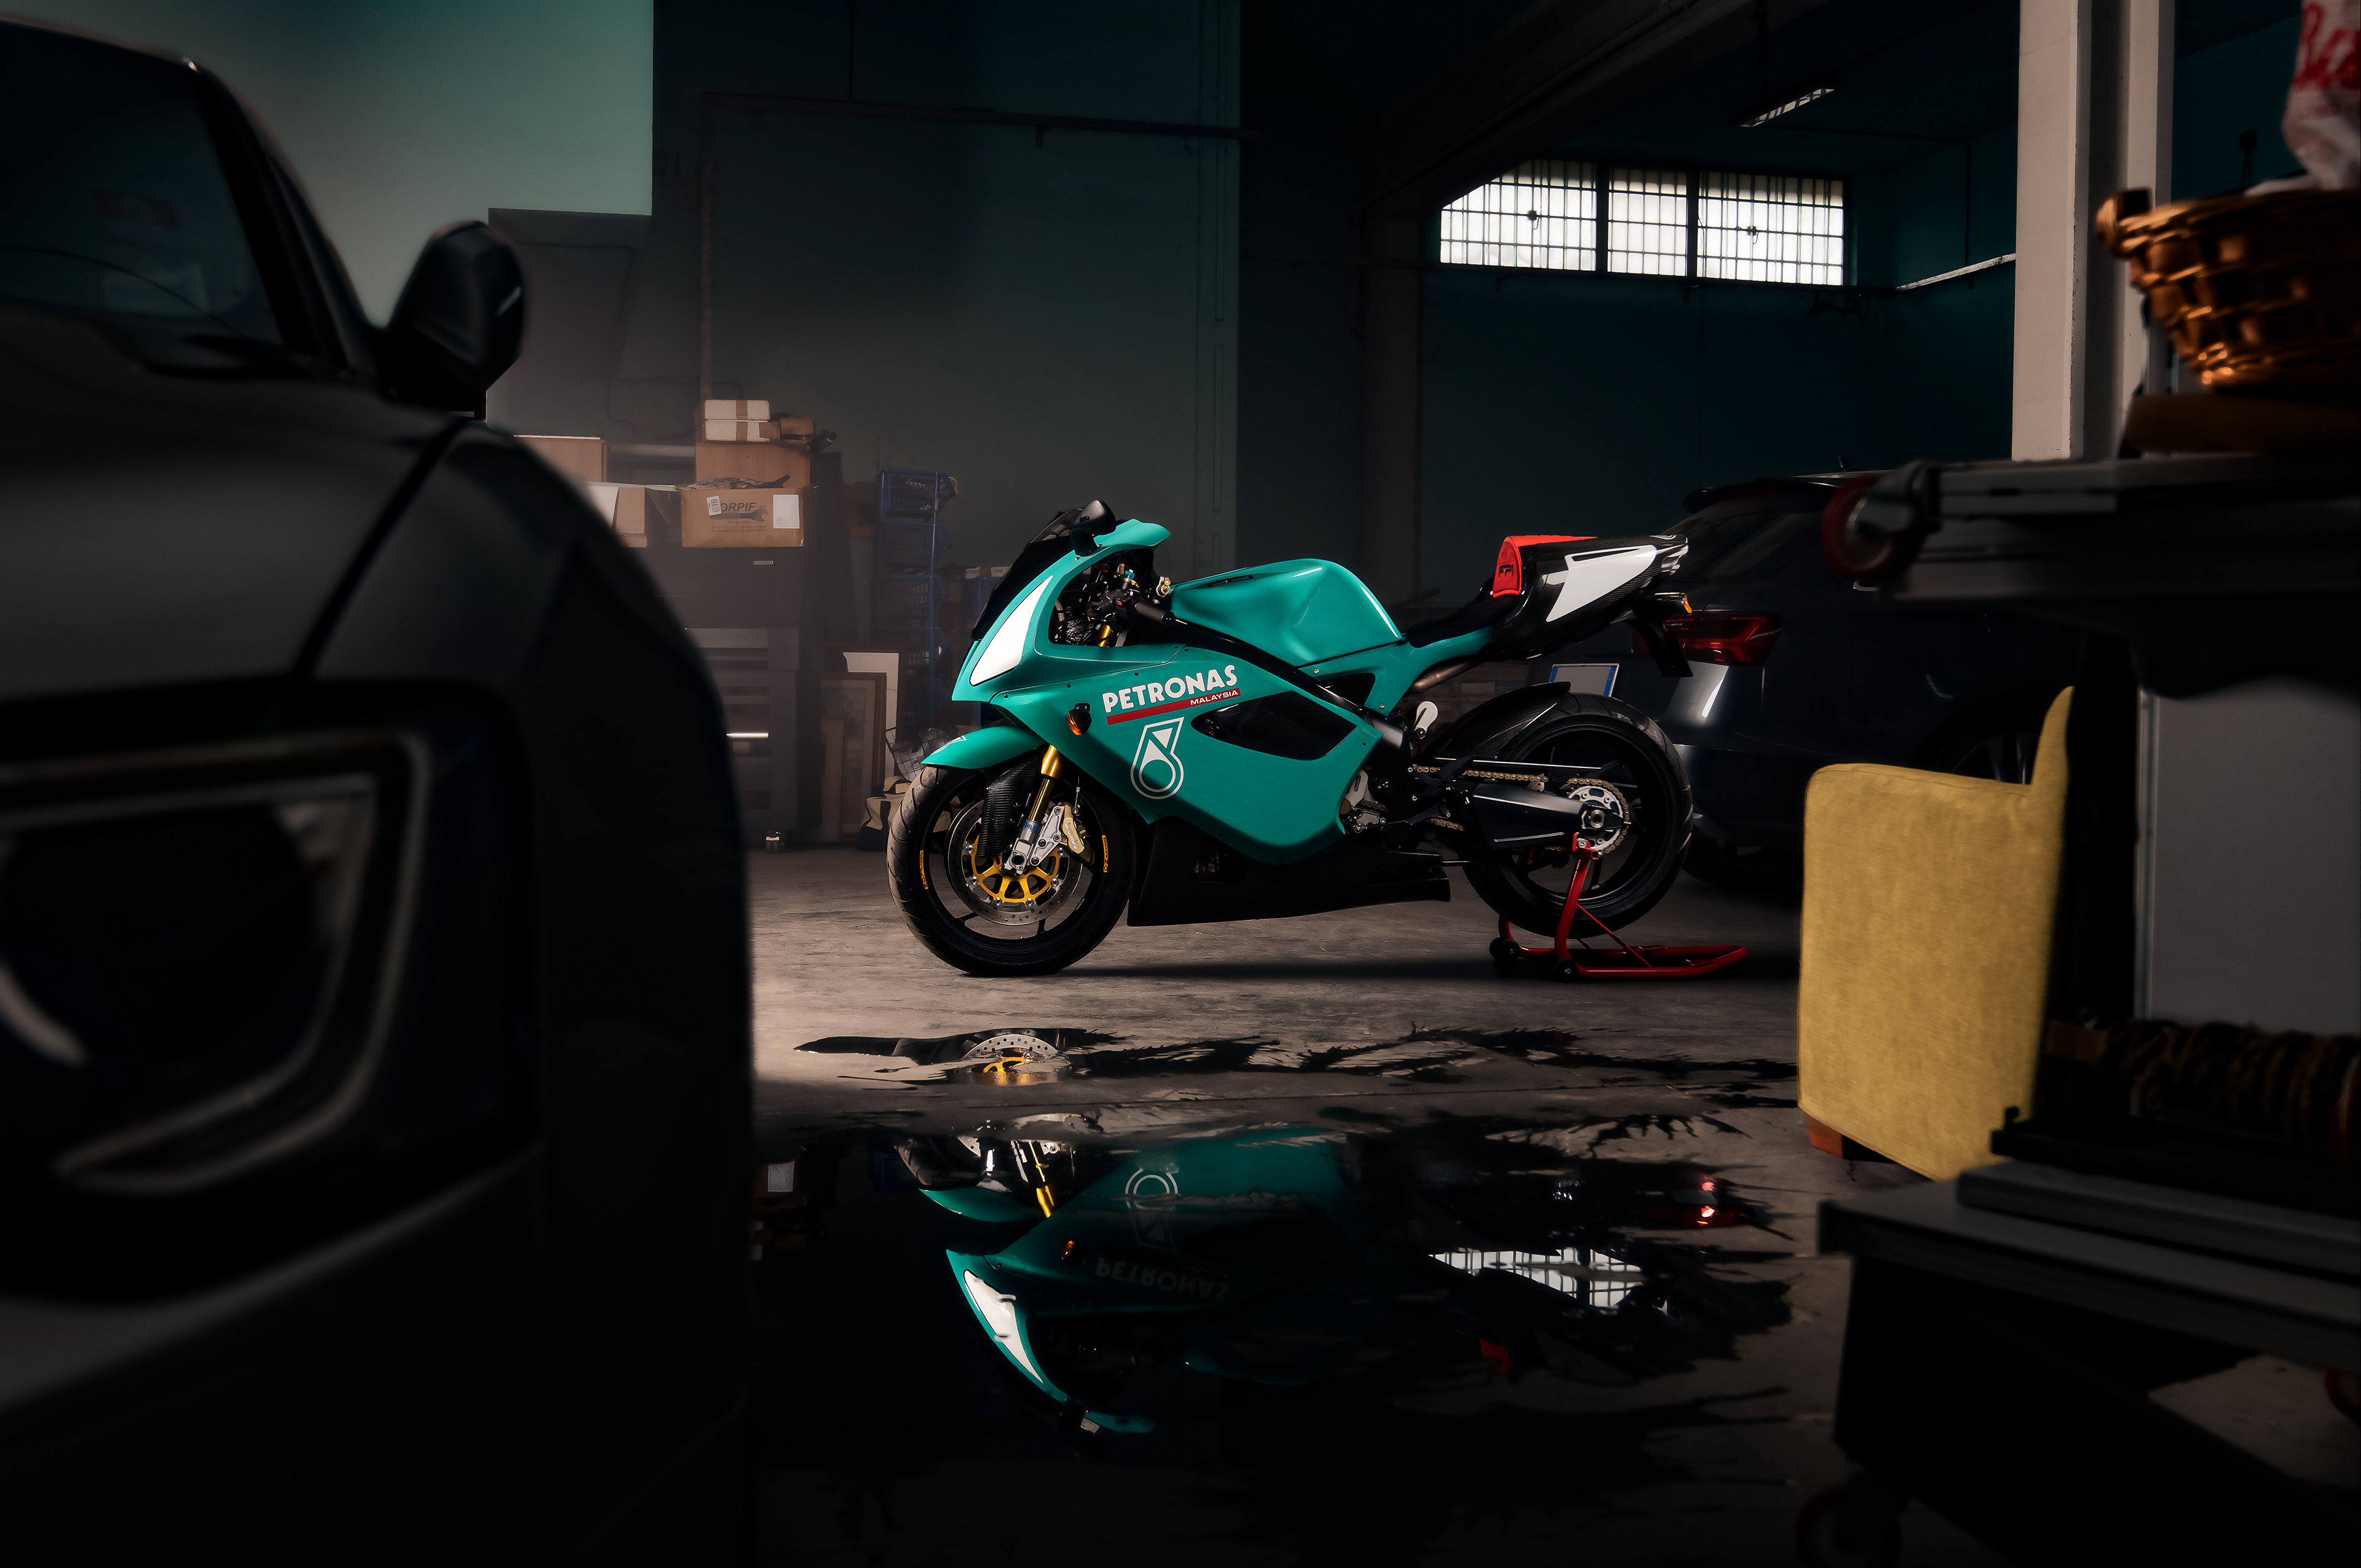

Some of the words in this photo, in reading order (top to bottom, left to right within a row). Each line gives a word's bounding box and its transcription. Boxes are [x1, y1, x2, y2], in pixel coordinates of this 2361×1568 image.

[720, 502, 756, 512] ORPIF
[1102, 665, 1238, 713] PETRONAS
[1190, 690, 1238, 706] MALAYSIA
[1065, 822, 1080, 850] brembo
